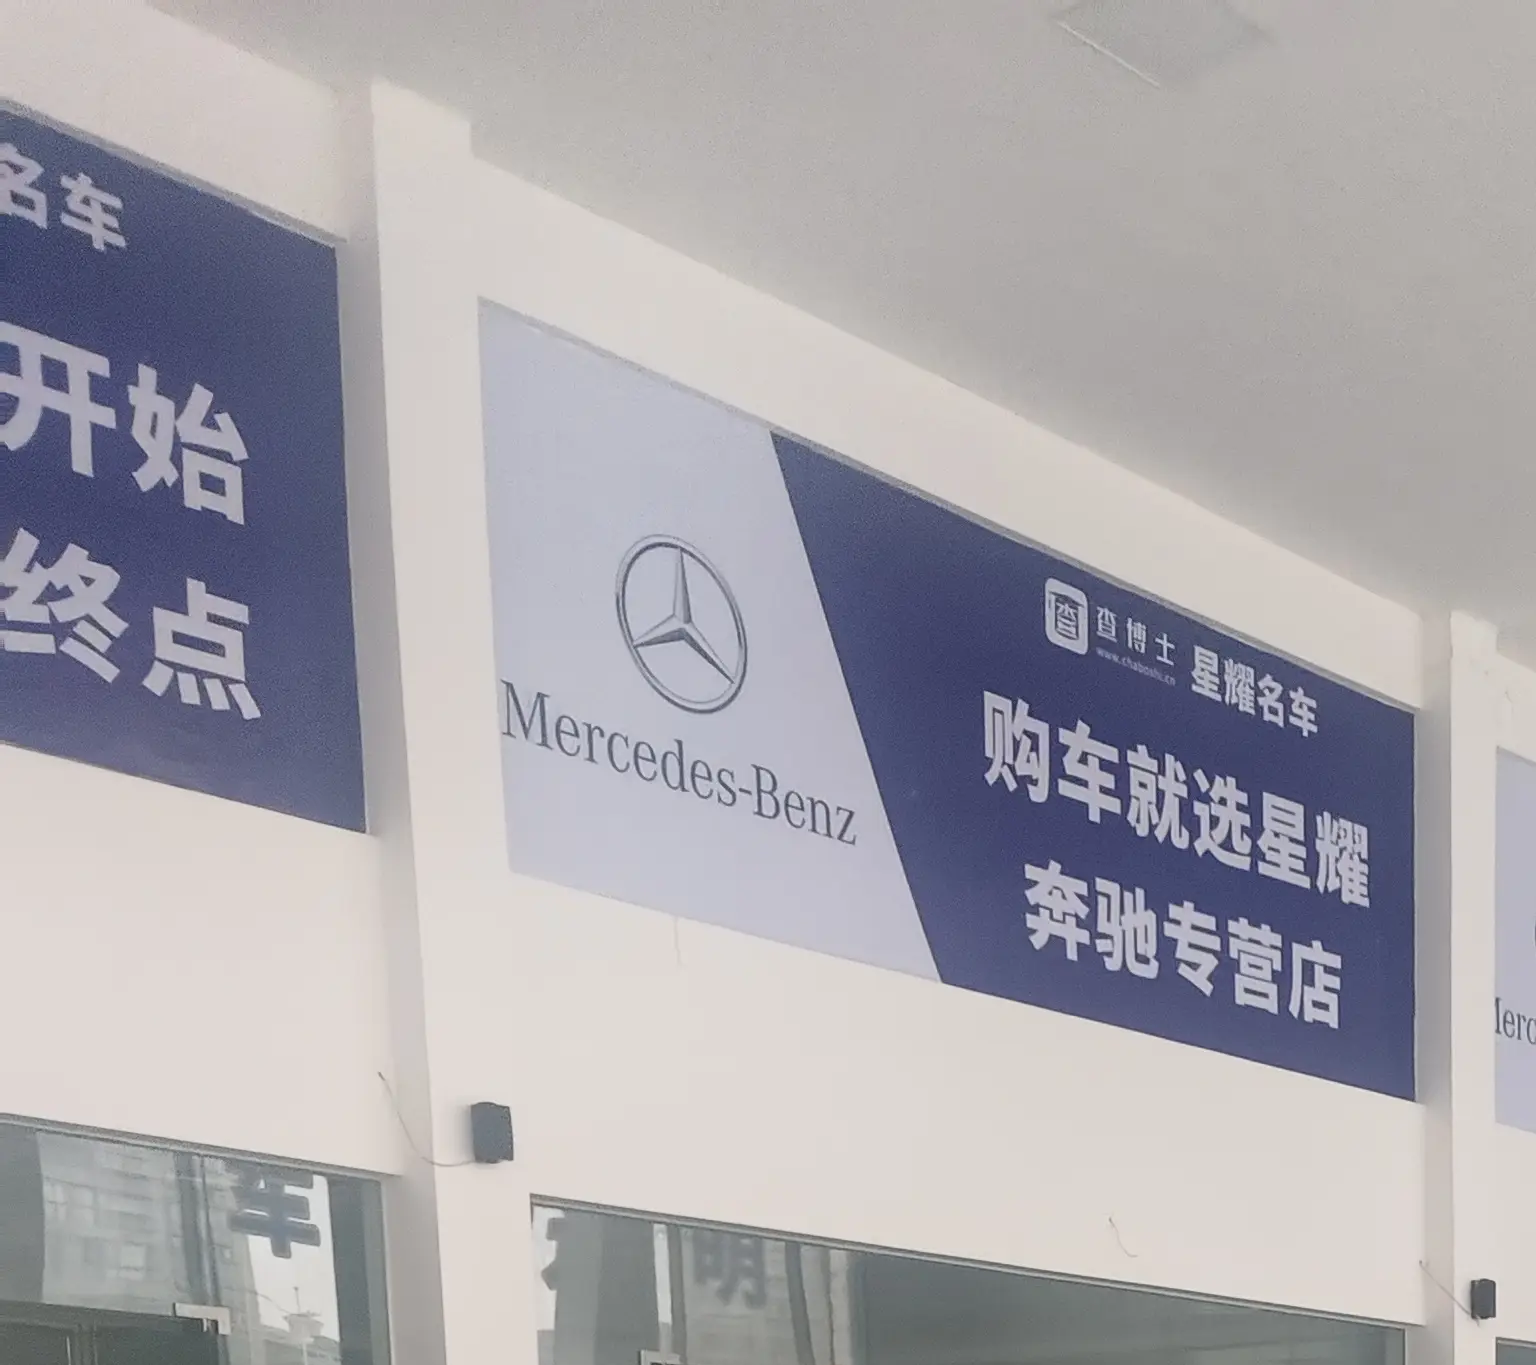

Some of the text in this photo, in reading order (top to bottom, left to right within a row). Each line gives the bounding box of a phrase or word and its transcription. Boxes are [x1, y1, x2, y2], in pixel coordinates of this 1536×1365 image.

[0, 321, 249, 525] 开始
[500, 679, 858, 846] Mercedes-Benz
[1191, 645, 1318, 737] 星耀名车
[983, 690, 1370, 908] 购车就选星耀
[1024, 859, 1342, 1030] 奔驰专营店
